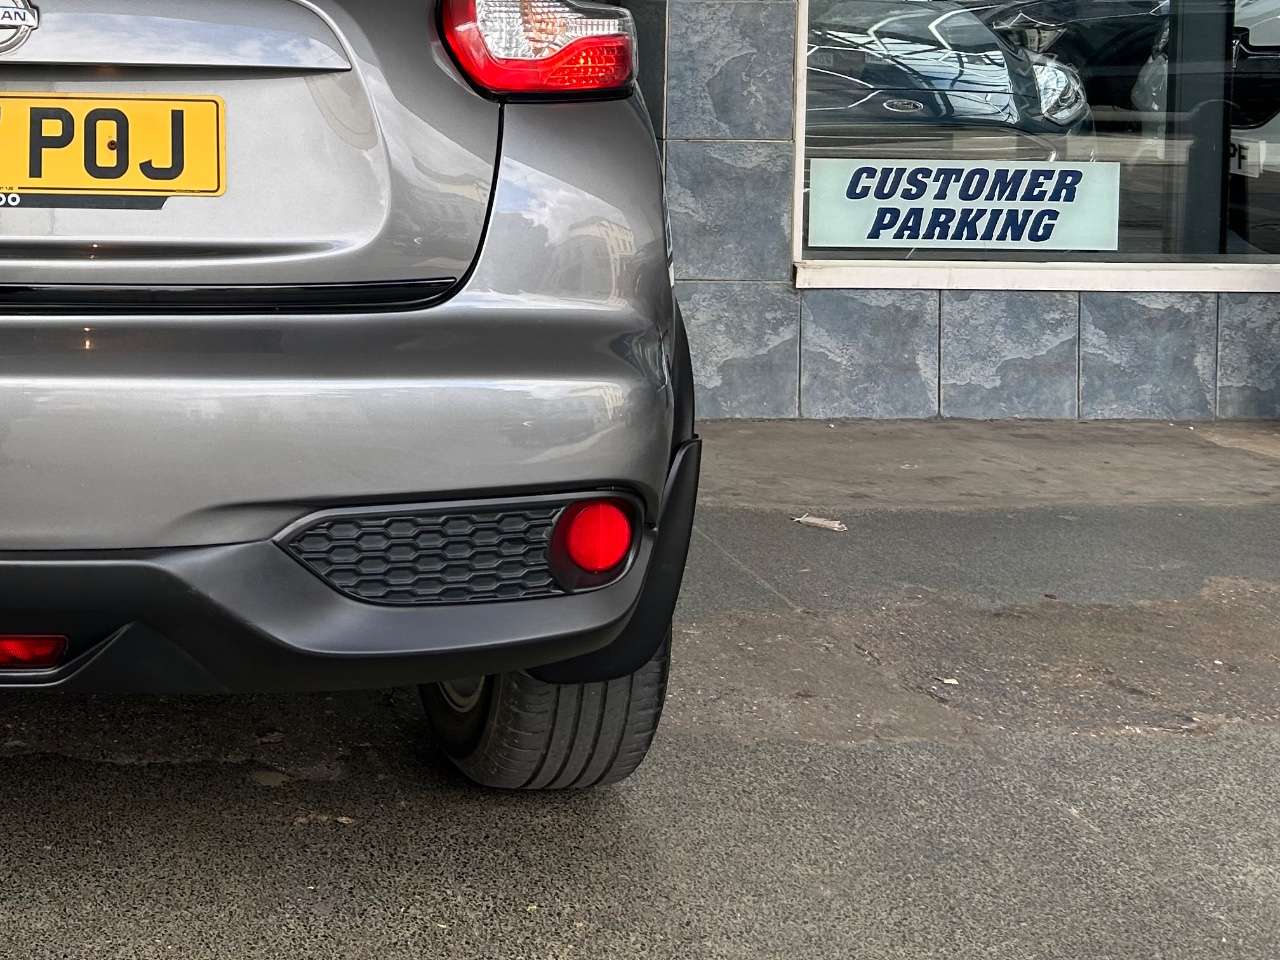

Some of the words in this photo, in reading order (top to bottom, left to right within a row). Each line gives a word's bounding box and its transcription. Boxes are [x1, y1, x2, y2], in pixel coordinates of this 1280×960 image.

[28, 106, 186, 181] POJ
[845, 166, 1084, 203] CUSTOMER
[866, 207, 1061, 243] PARKING
